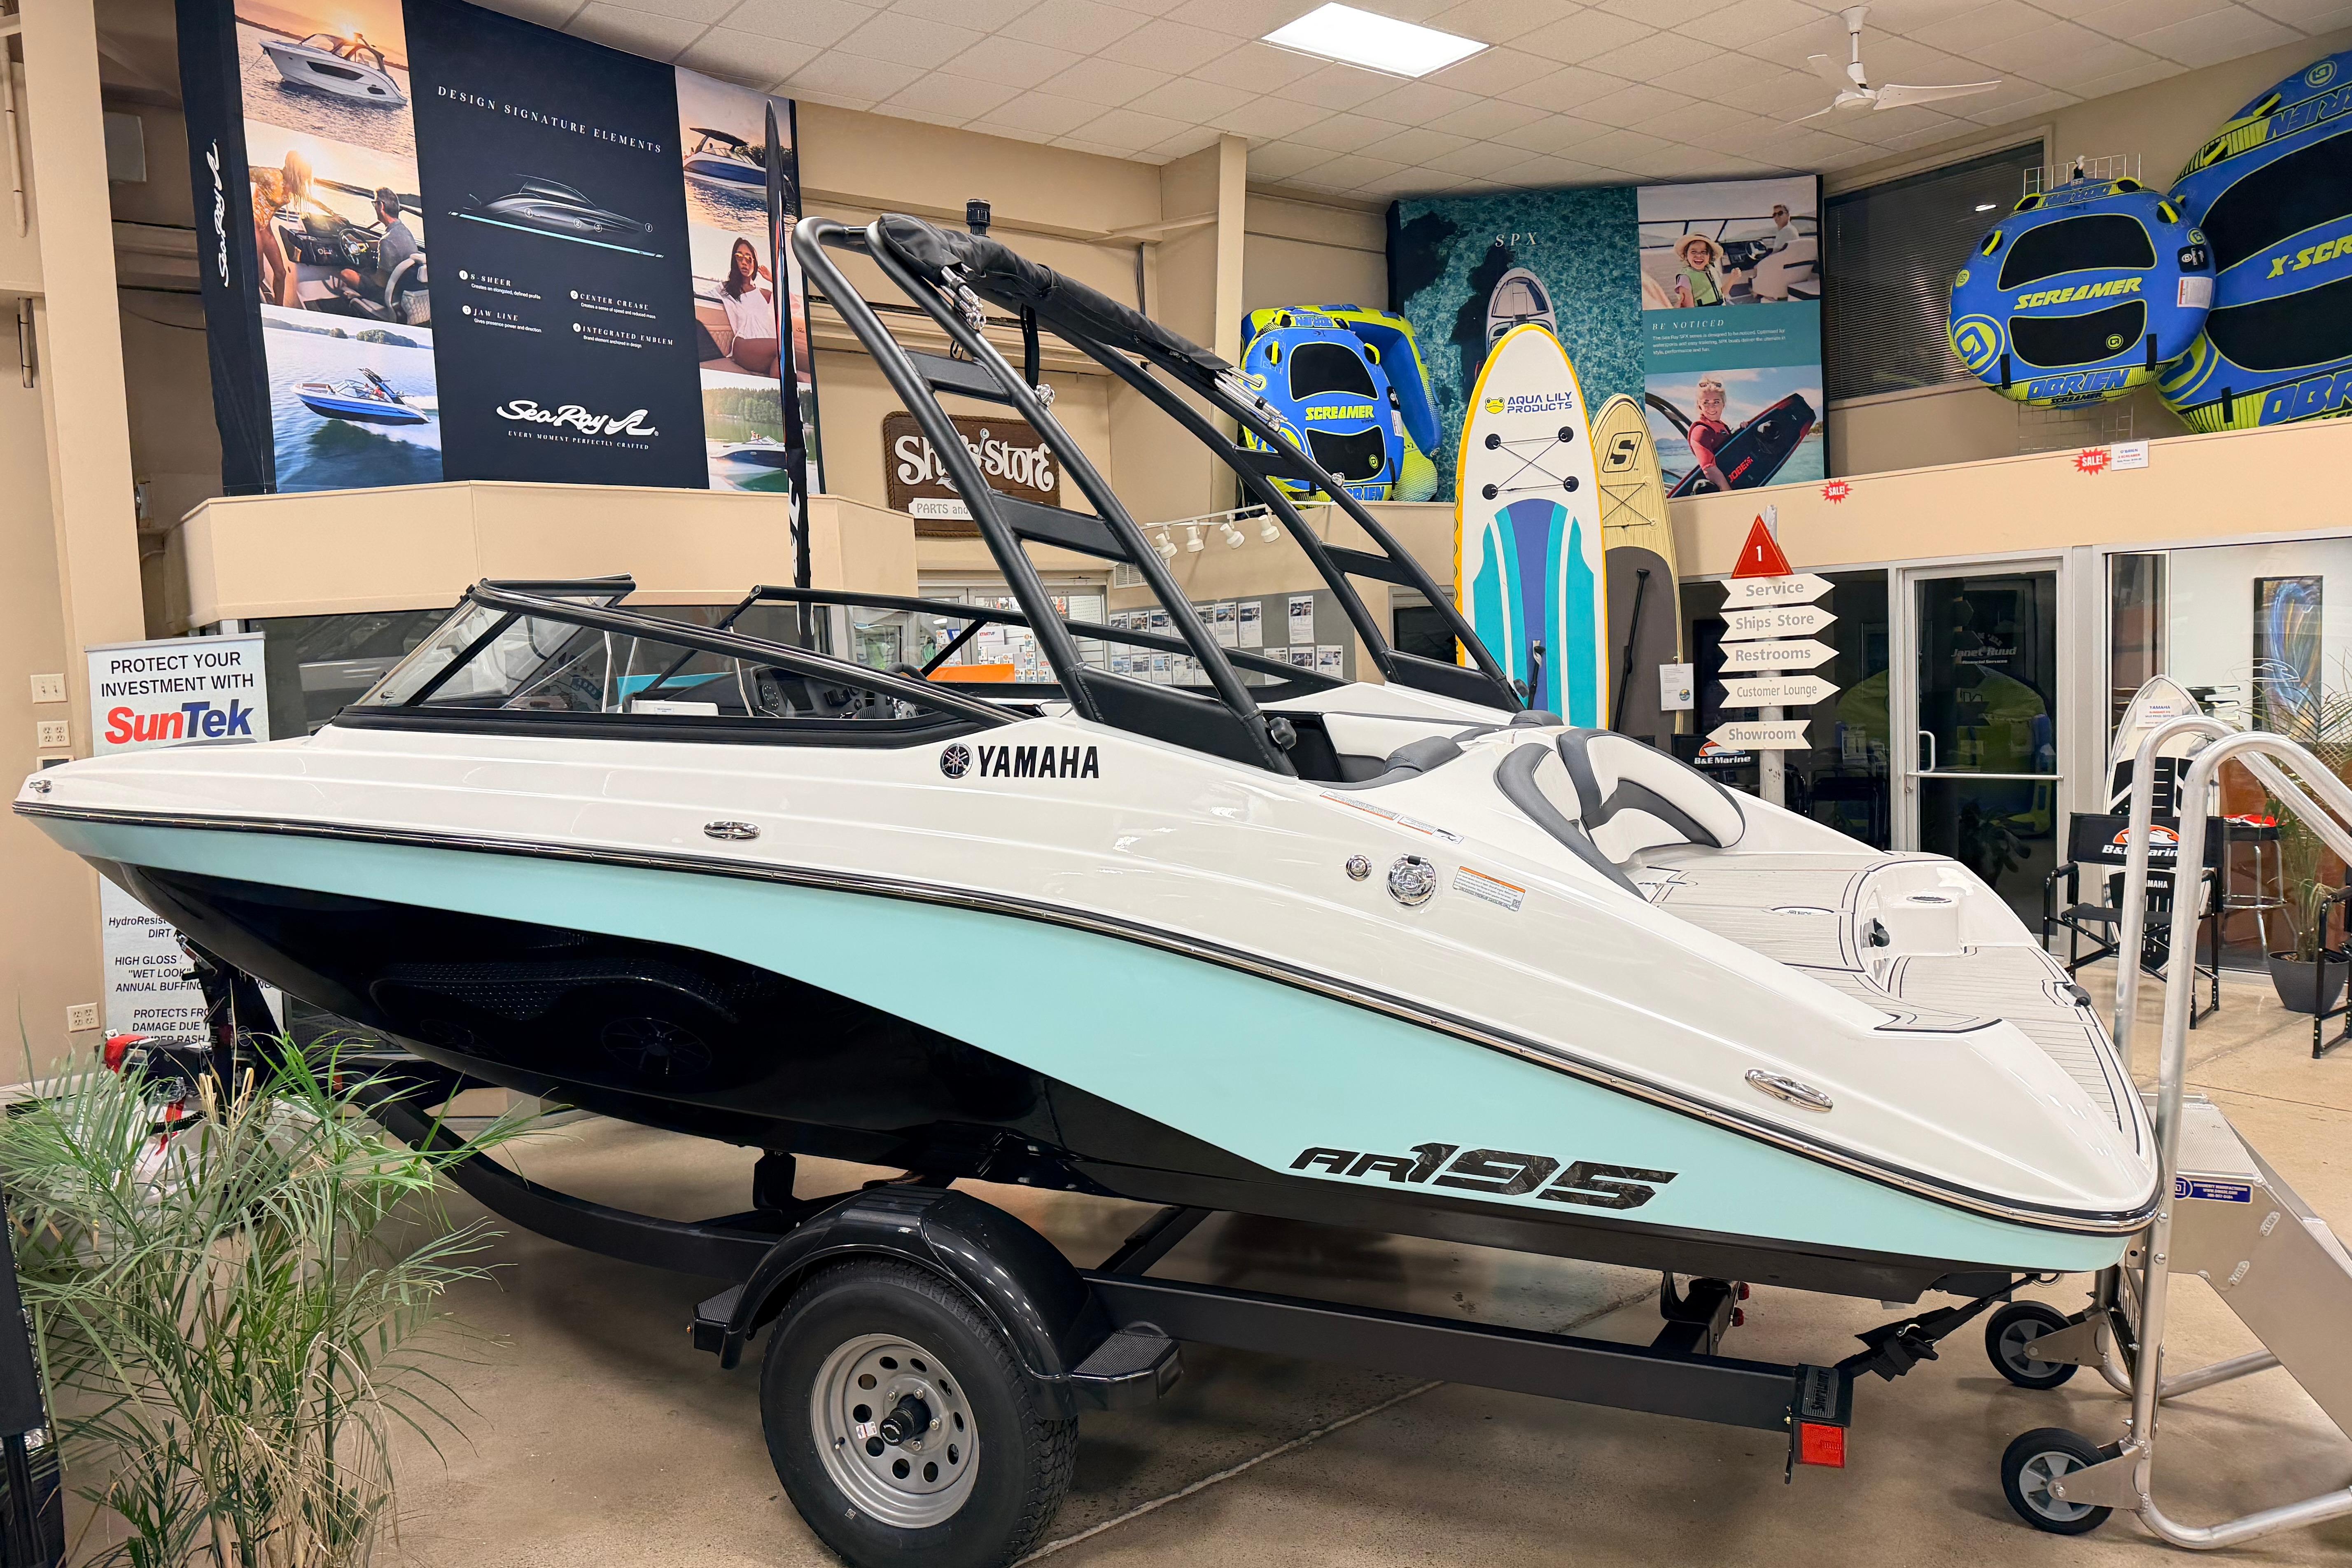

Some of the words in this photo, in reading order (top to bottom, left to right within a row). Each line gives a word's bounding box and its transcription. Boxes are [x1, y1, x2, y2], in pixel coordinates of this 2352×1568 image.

[438, 86, 495, 110] DESIGN
[504, 105, 586, 134] SIGNATURE
[594, 128, 662, 153] ELEMENTS
[214, 188, 226, 237] Ray
[1495, 232, 1537, 247] SPX
[219, 235, 229, 287] Sea
[2014, 277, 2142, 310] SCREAMER
[580, 293, 612, 304] CENTER
[617, 300, 649, 310] CREASE
[474, 308, 492, 317] JAW
[497, 313, 518, 321] LINE
[1673, 320, 1724, 329] NOTICED
[583, 326, 636, 340] INTEGRATED
[641, 335, 673, 345] EMBLEM
[2027, 369, 2131, 399] OBRIEN
[1507, 394, 1542, 405] AQUA
[1546, 392, 1572, 404] LILY
[2051, 392, 2102, 404] SCREAMER
[1305, 405, 1375, 421] SCREAMER
[1507, 401, 1573, 414] PRODUCTS
[497, 400, 558, 423] Sea
[553, 405, 609, 435] Ray
[537, 434, 569, 442] MOMENT
[573, 437, 613, 446] PERFECTLY
[2081, 455, 2103, 467] SALE!
[1828, 487, 1846, 495] SALE!
[917, 503, 948, 514] PARTS
[1756, 545, 1762, 562] 1
[1746, 581, 1804, 597] Service
[1736, 616, 1771, 631] Ships
[1778, 614, 1814, 626] Store
[1735, 648, 1811, 661] Restrooms
[111, 655, 188, 674] PROTECT
[194, 652, 241, 668] YOUR
[101, 677, 206, 697] INVESTMENT
[211, 673, 254, 690] WITH
[1736, 685, 1780, 698] Customer
[1784, 684, 1817, 698] Lounge
[105, 699, 255, 744] SunTek
[1729, 728, 1797, 741] Showroom
[978, 746, 1099, 778] YAMAHA
[2102, 845, 2128, 855] B&
[149, 929, 171, 938] DIRT
[115, 956, 140, 966] HIGH
[142, 955, 177, 964] GLOSS
[116, 982, 156, 992] ANNUAL
[134, 1008, 188, 1018] PROTECTS
[133, 1022, 176, 1031] DAMAGE
[180, 1021, 200, 1030] DUE
